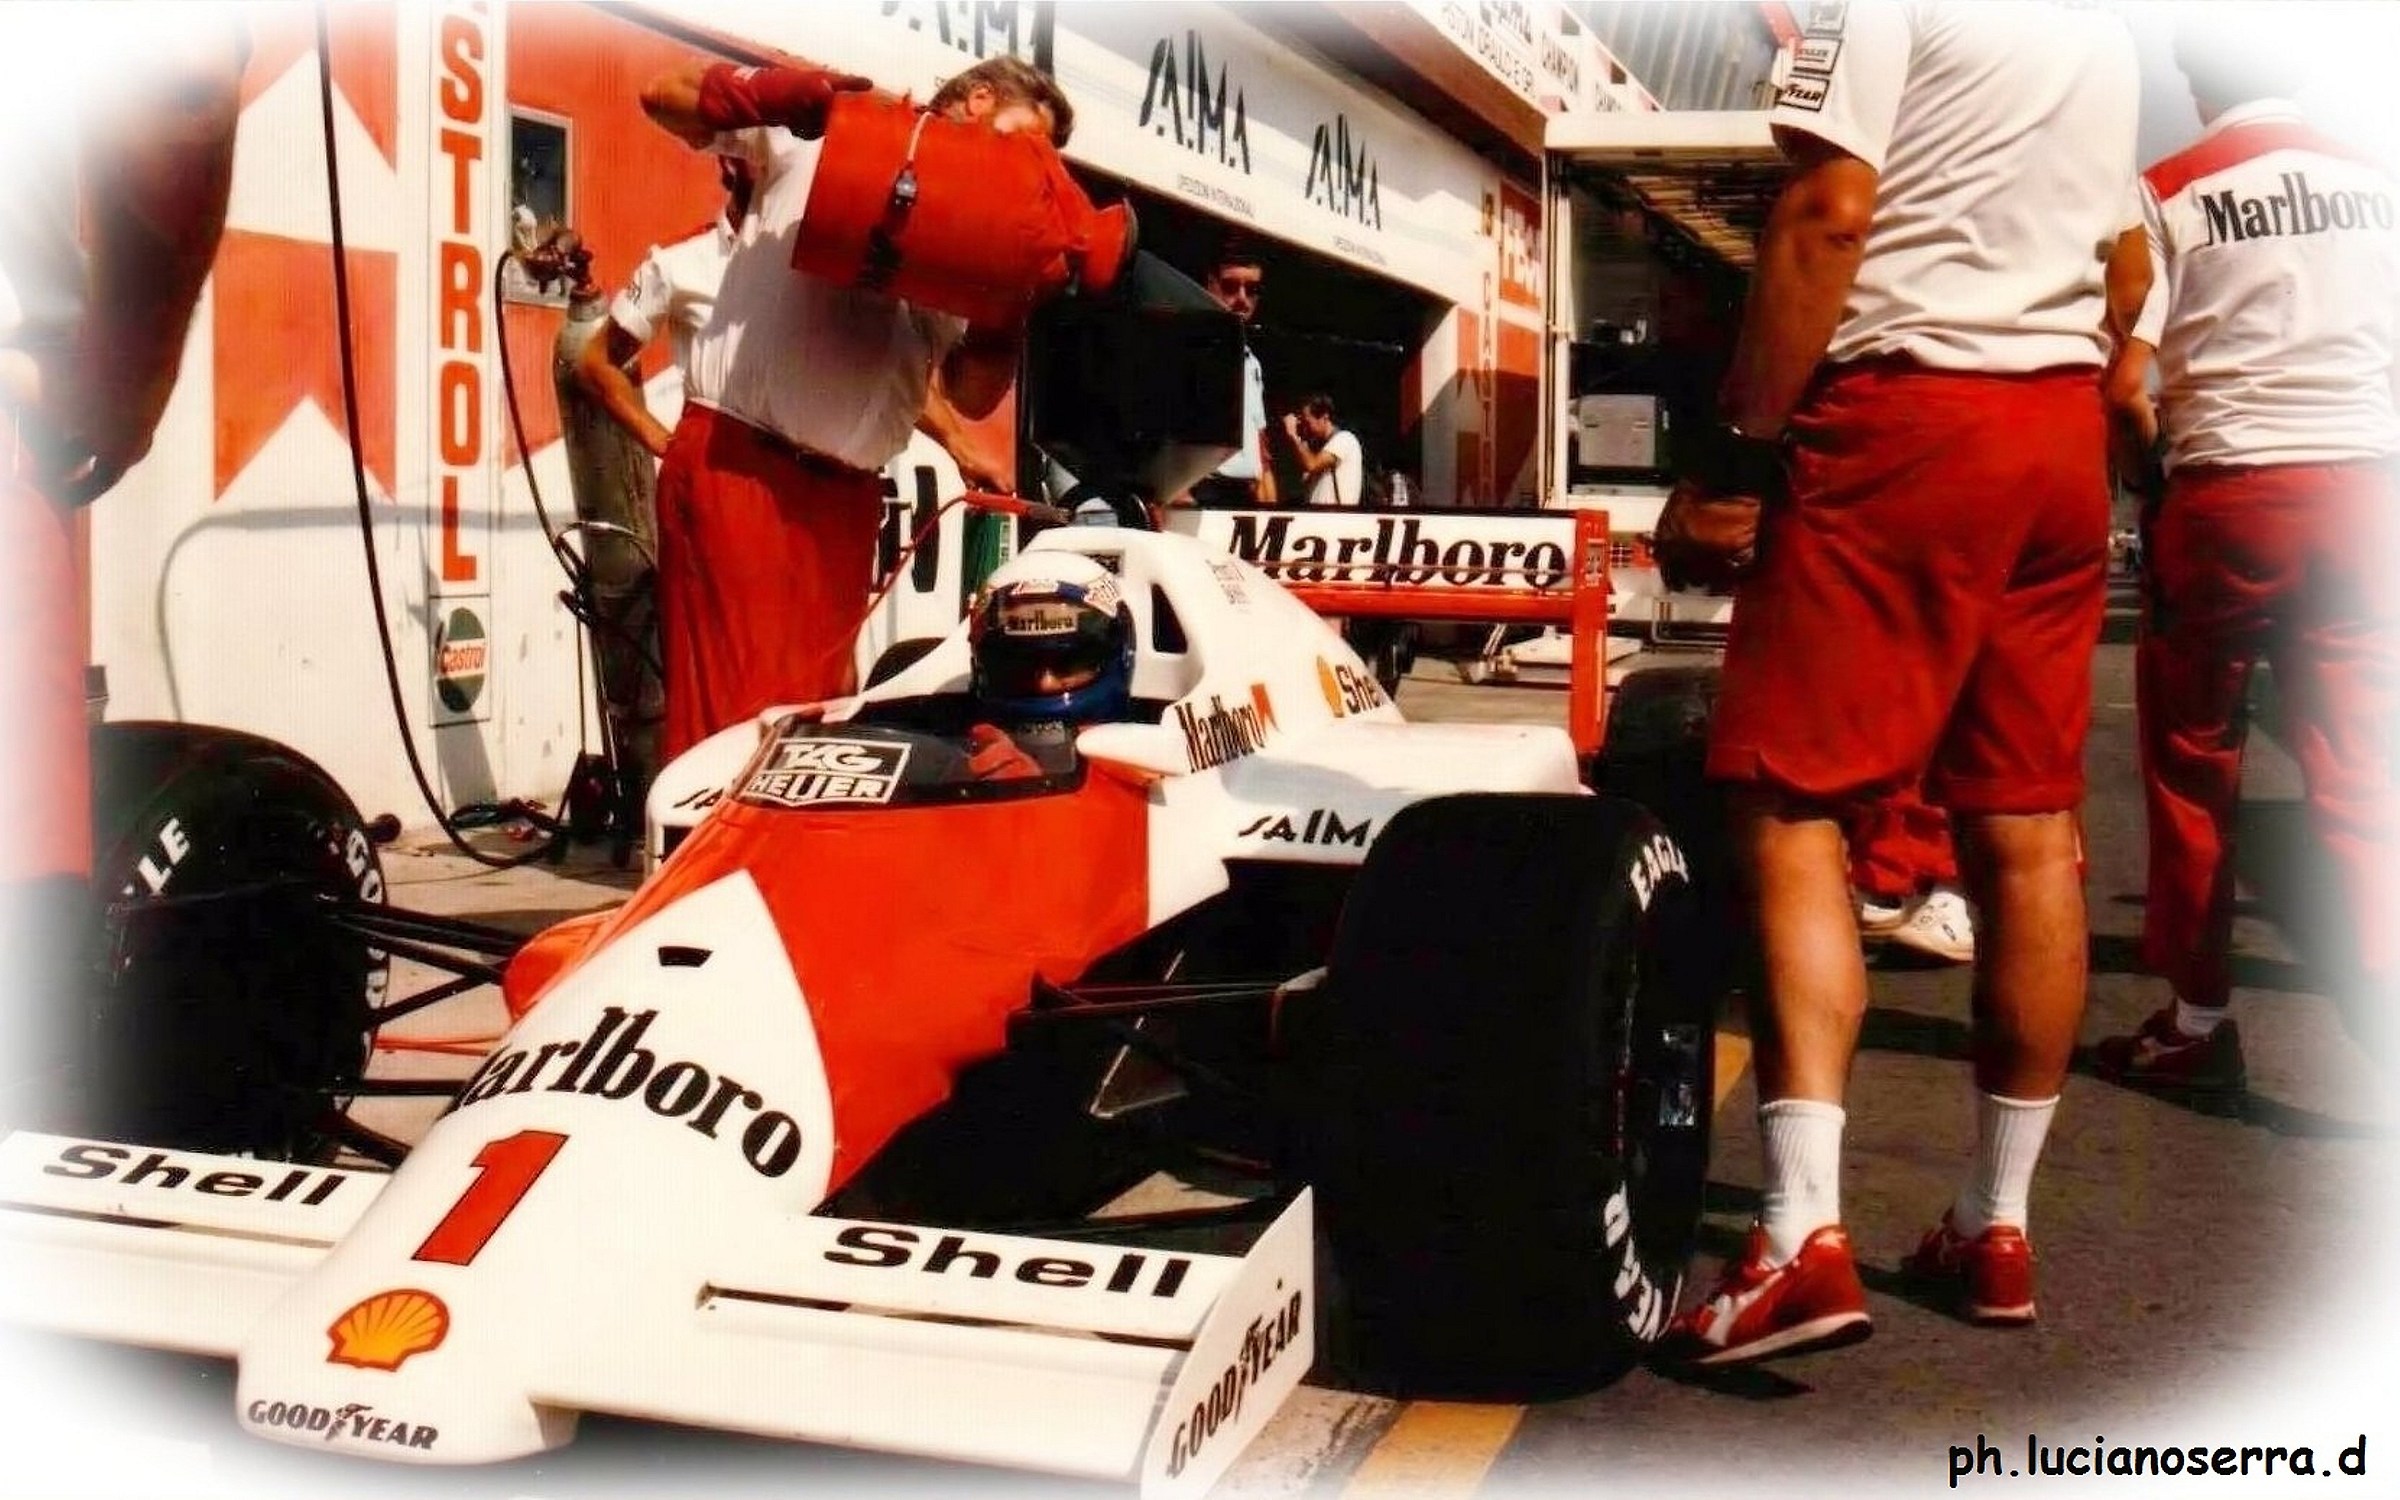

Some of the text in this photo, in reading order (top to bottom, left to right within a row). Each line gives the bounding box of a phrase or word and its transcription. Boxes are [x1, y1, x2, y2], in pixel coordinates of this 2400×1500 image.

[2200, 172, 2394, 247] Marlboro
[1229, 516, 1566, 588] Marlboro
[1006, 610, 1074, 633] Marlboro
[782, 742, 884, 774] TAG
[1175, 695, 1266, 774] Marlboro
[748, 773, 884, 800] HEUER
[433, 1006, 802, 1178] arlboro
[42, 1143, 347, 1206] Shell
[410, 1128, 571, 1267] 1
[824, 1225, 1192, 1299] Shell
